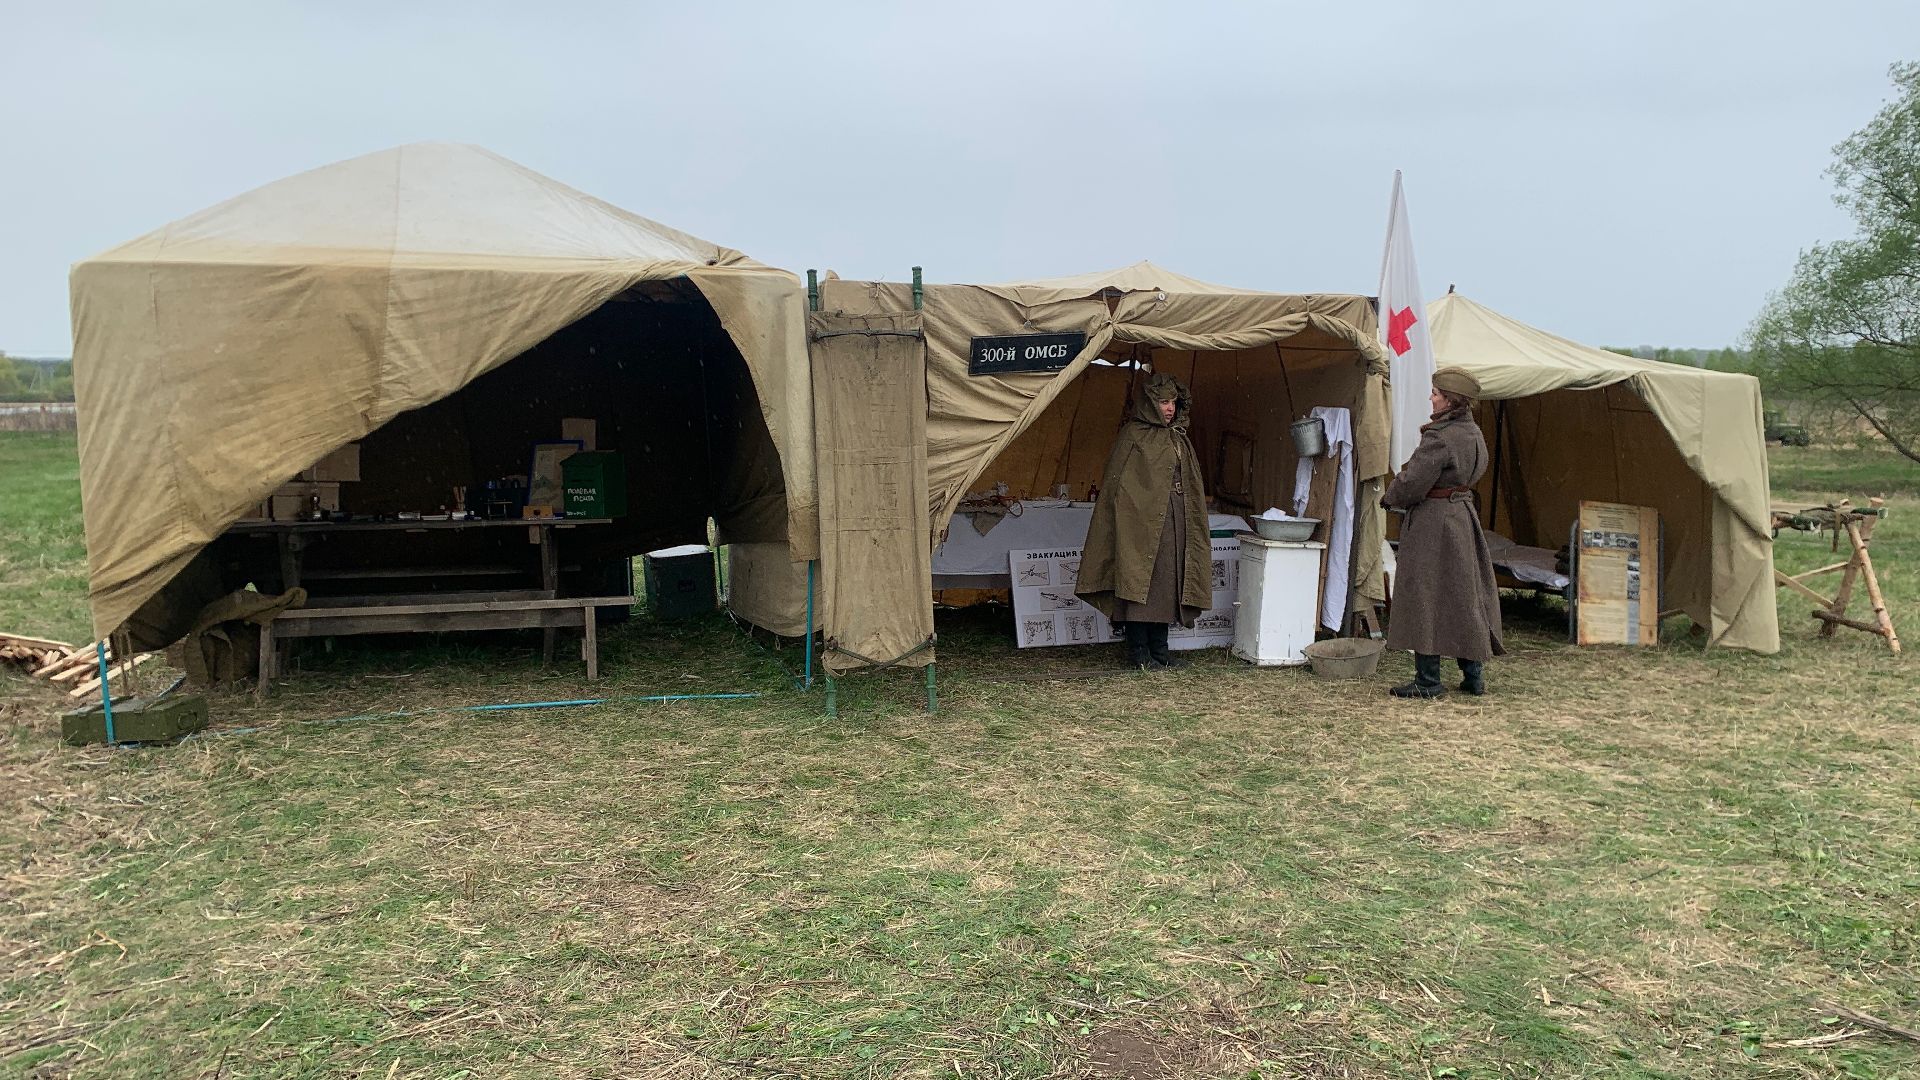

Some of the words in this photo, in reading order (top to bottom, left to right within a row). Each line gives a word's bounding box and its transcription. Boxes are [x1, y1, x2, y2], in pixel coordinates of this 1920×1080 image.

[980, 347, 1016, 362] 300-й
[1024, 344, 1068, 359] ОМСБ
[567, 487, 597, 495] ПОЛЕВАЯ
[1026, 550, 1077, 559] ЭВАКУАЦИЯ
